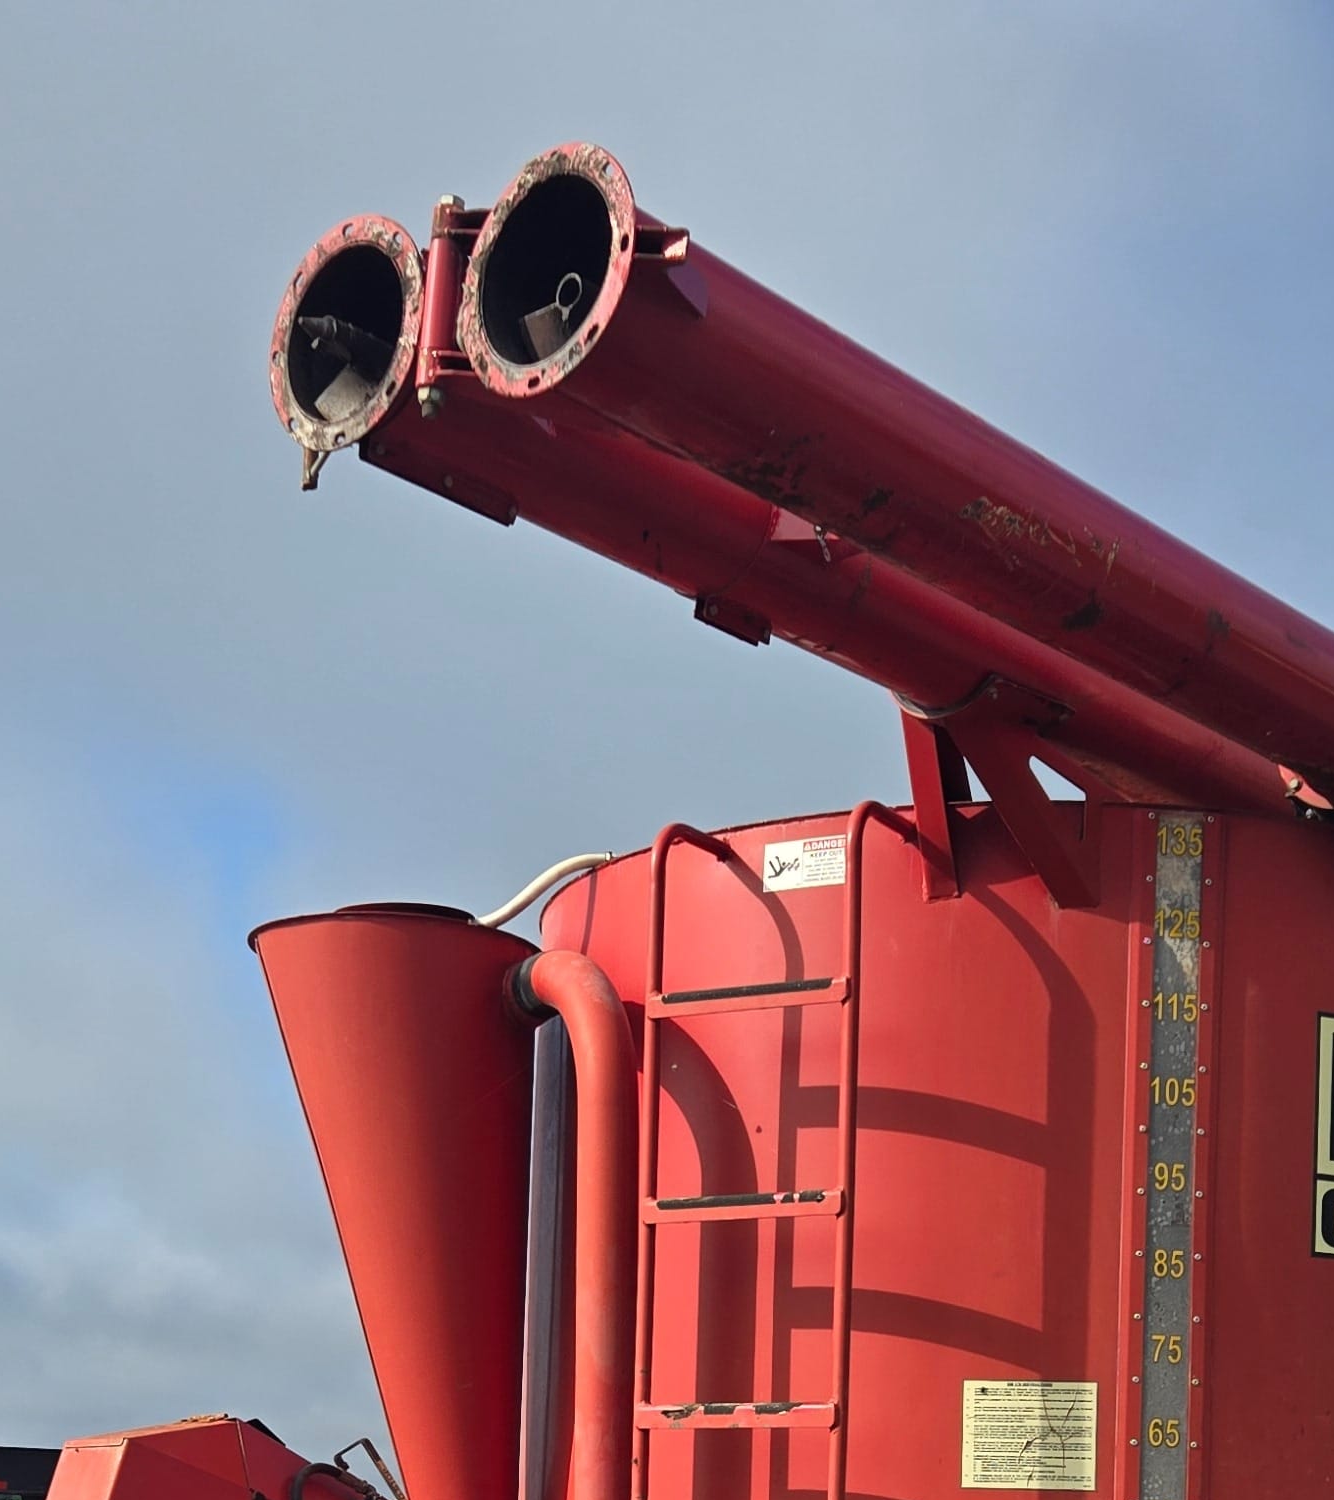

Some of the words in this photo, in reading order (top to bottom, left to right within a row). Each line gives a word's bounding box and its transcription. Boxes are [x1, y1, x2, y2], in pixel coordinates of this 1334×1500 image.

[811, 839, 847, 850] DANGE
[1157, 826, 1203, 856] 135
[1155, 909, 1200, 938] 125
[1153, 994, 1197, 1022] 115
[1150, 1079, 1196, 1107] 105
[1154, 1164, 1186, 1192] 95
[1153, 1249, 1185, 1278] 85
[1151, 1335, 1183, 1363] 75
[1148, 1419, 1181, 1448] 65
